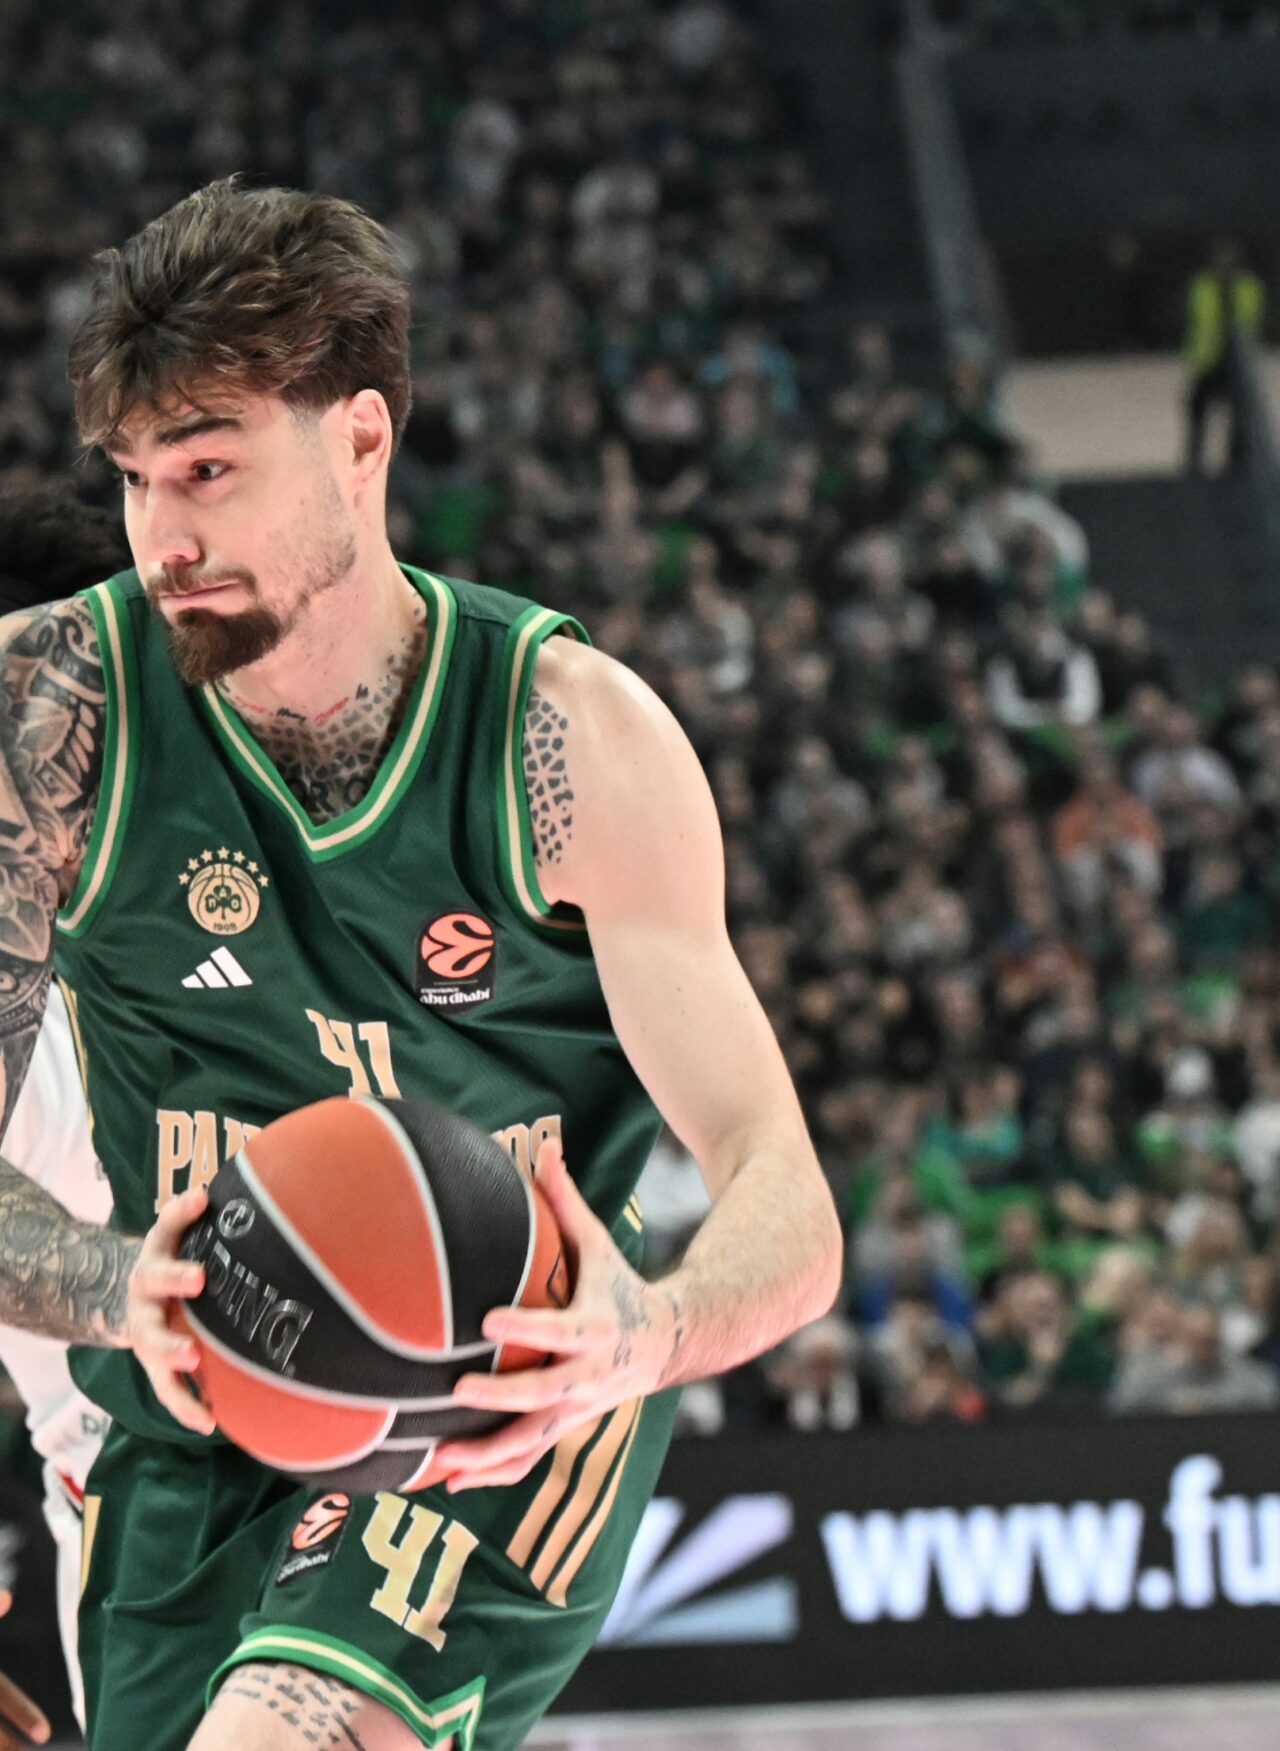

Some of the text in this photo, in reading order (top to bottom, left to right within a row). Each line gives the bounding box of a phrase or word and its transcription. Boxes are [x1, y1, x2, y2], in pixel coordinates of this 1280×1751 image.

[305, 1008, 402, 1100] 41
[361, 1491, 480, 1653] 41
[821, 1454, 1280, 1623] www.fu
